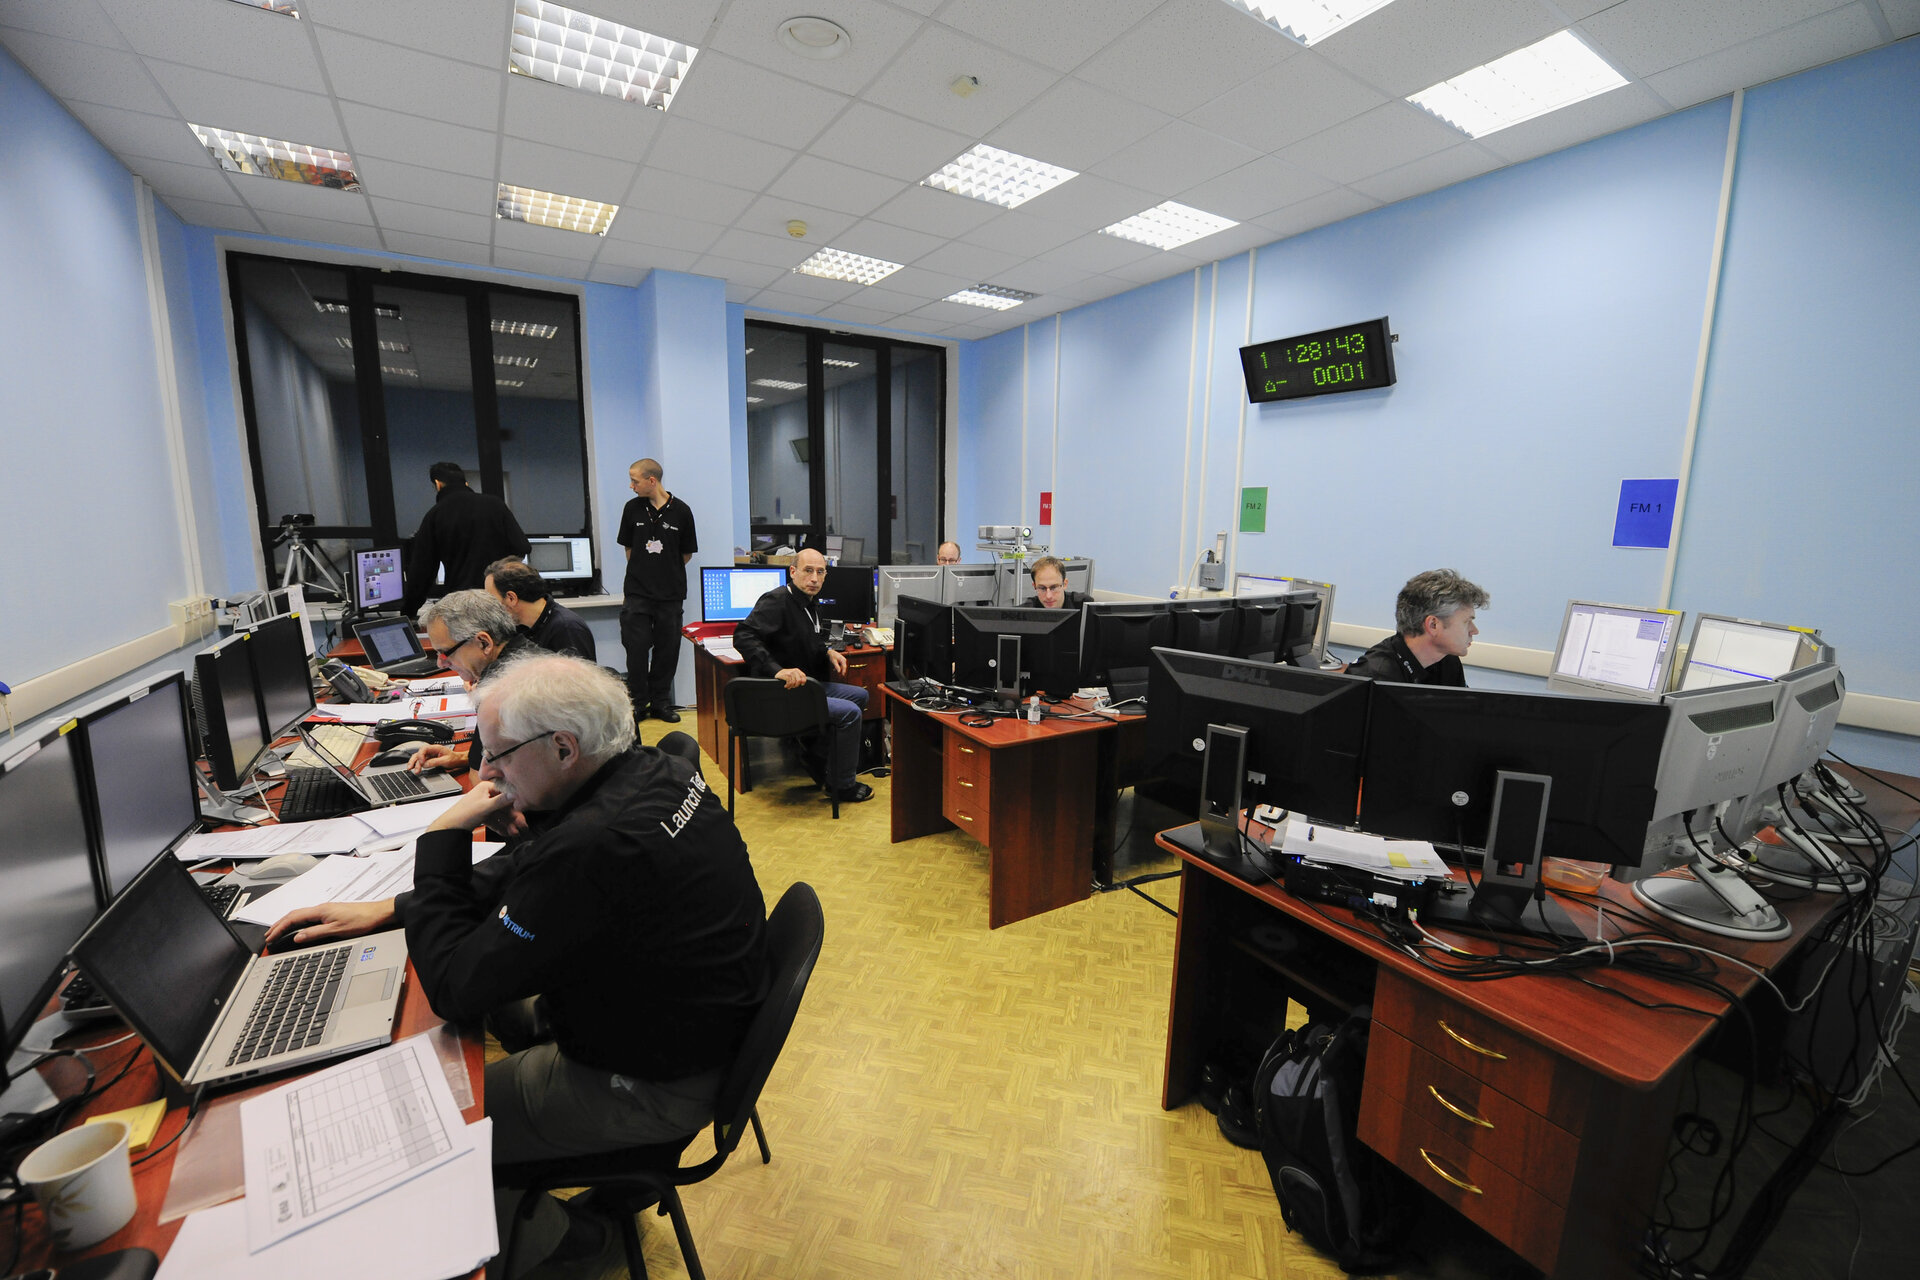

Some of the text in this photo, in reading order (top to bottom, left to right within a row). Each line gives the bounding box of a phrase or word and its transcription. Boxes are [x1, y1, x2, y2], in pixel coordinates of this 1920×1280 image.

[1313, 361, 1364, 386] 0001
[1246, 502, 1256, 510] FM
[1630, 503, 1661, 513] FM 1
[660, 786, 702, 838] Launch
